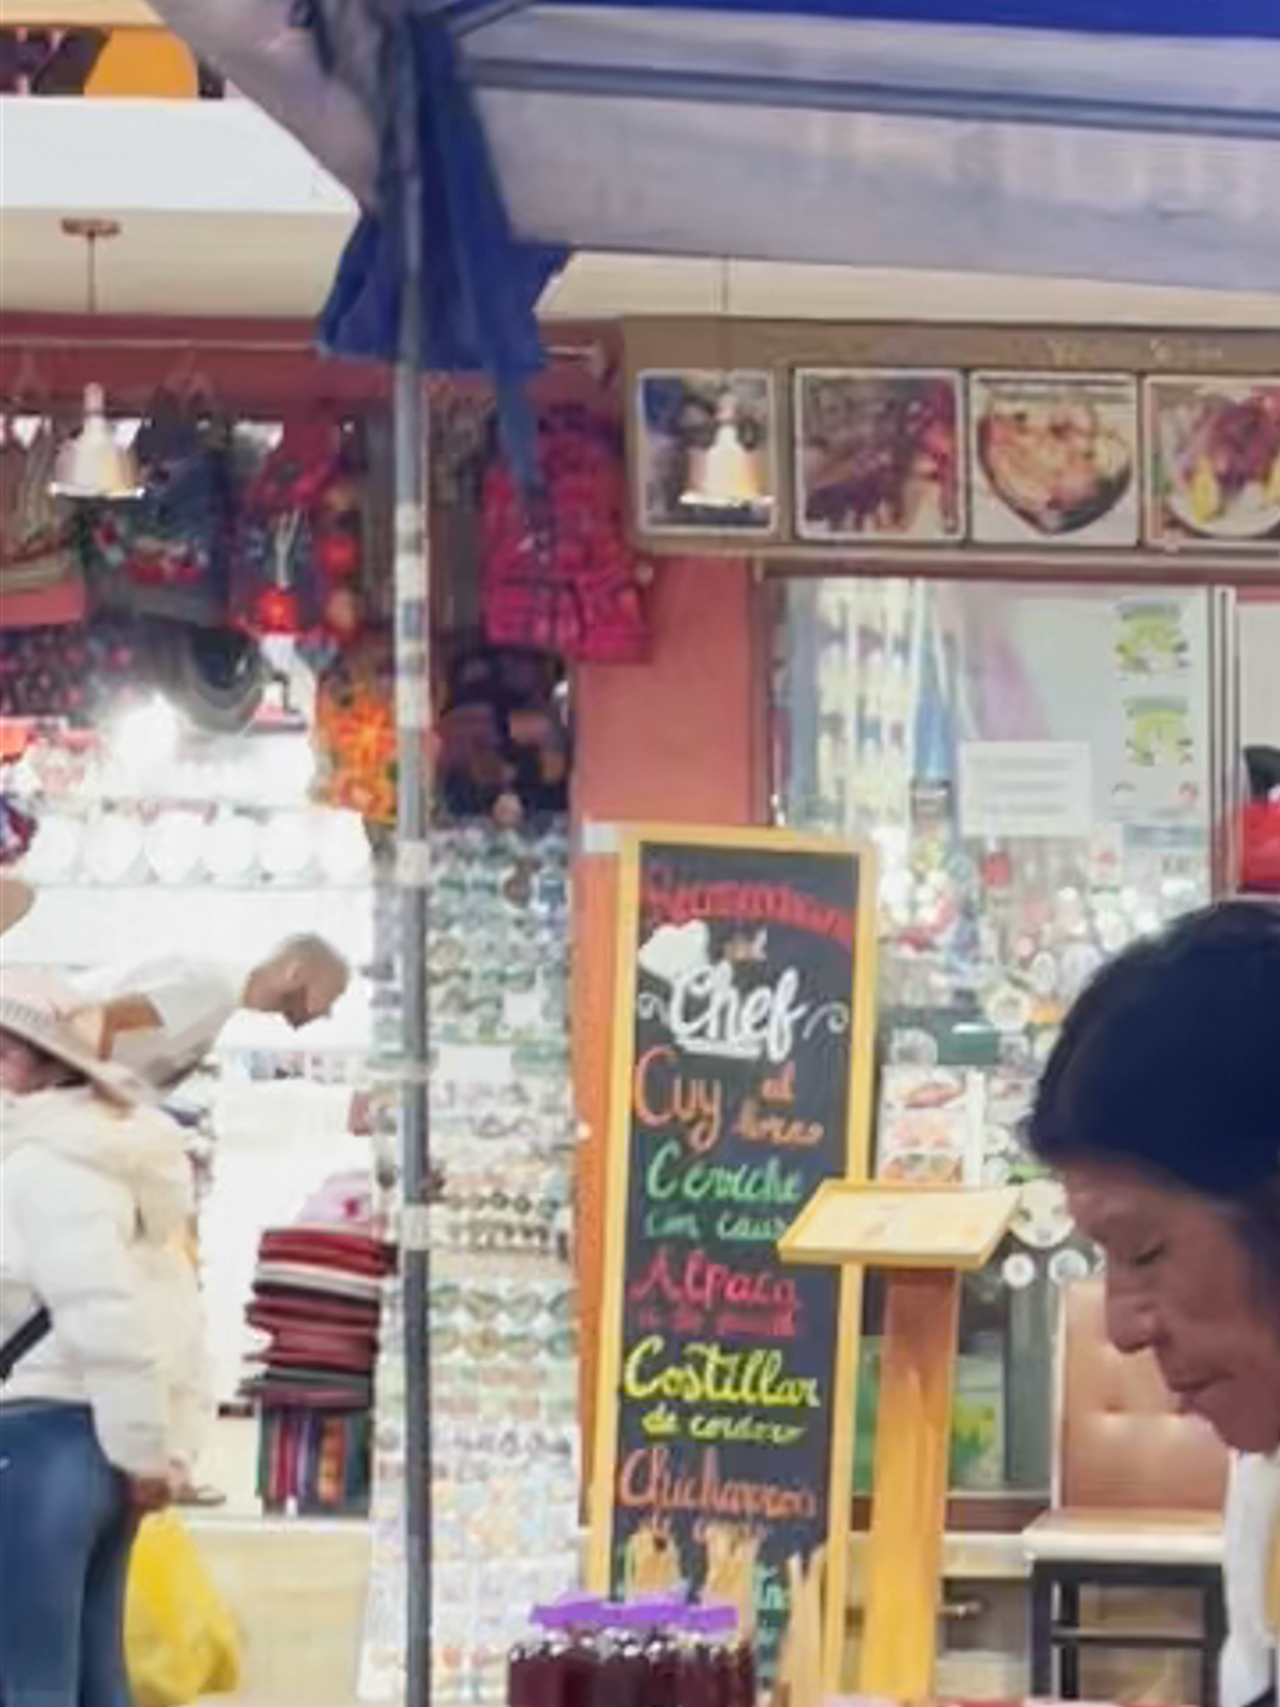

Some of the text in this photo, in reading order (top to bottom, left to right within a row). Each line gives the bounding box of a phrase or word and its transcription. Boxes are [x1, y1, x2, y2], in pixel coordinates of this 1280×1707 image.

[669, 959, 808, 1063] Chef
[633, 1044, 723, 1151] Cuy
[623, 1334, 821, 1408] Costillar
